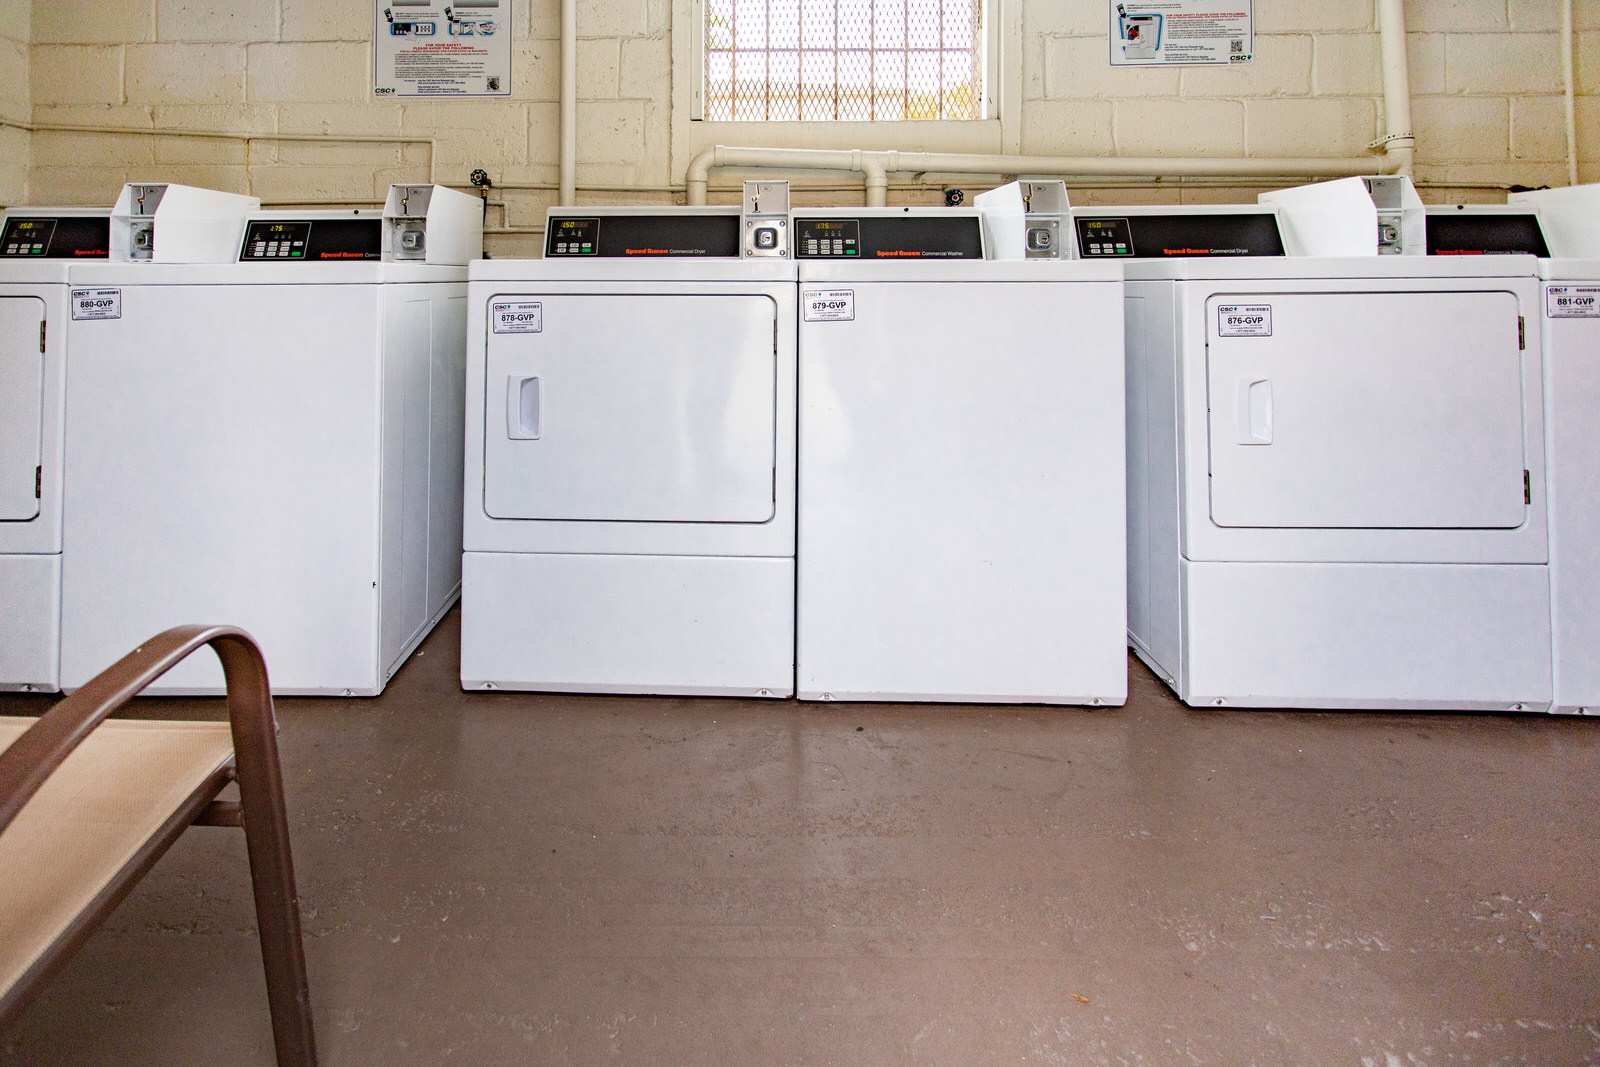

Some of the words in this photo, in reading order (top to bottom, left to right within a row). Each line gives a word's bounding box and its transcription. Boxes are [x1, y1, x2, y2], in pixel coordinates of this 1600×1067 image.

[80, 300, 114, 308] 880-GVP
[812, 301, 847, 309] 879-GVP
[501, 313, 535, 321] 878-GVP
